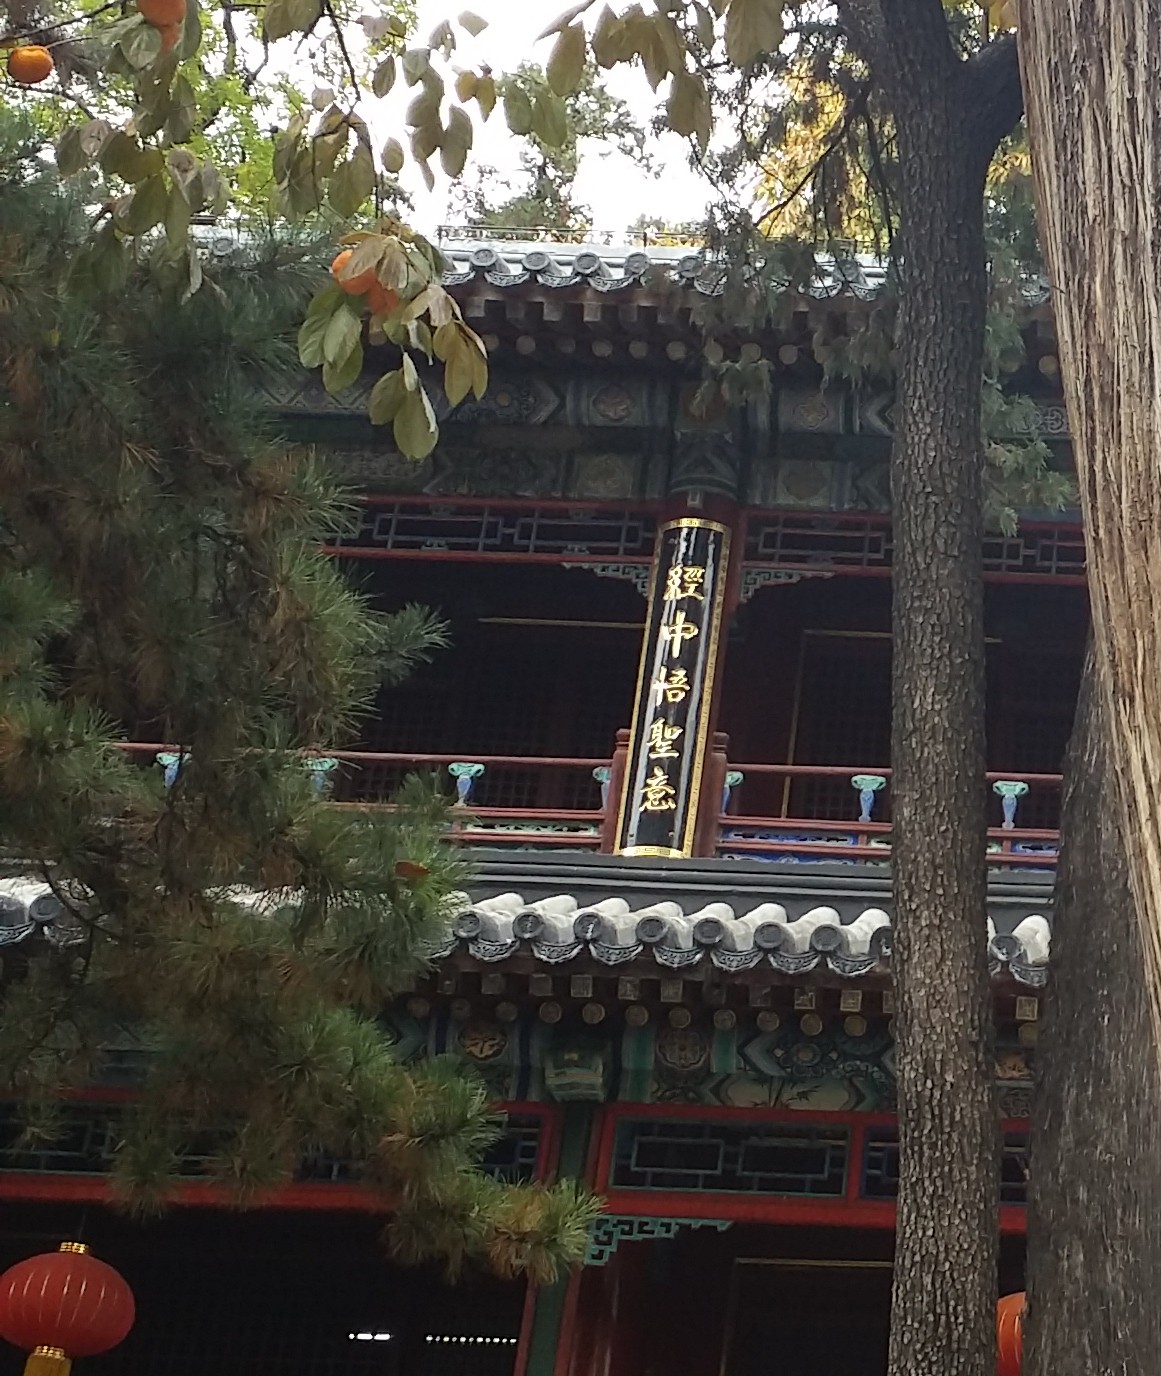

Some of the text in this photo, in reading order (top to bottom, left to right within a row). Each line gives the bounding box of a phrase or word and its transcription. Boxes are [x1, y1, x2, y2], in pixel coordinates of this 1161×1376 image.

[638, 564, 705, 812] 經中悟聖意
